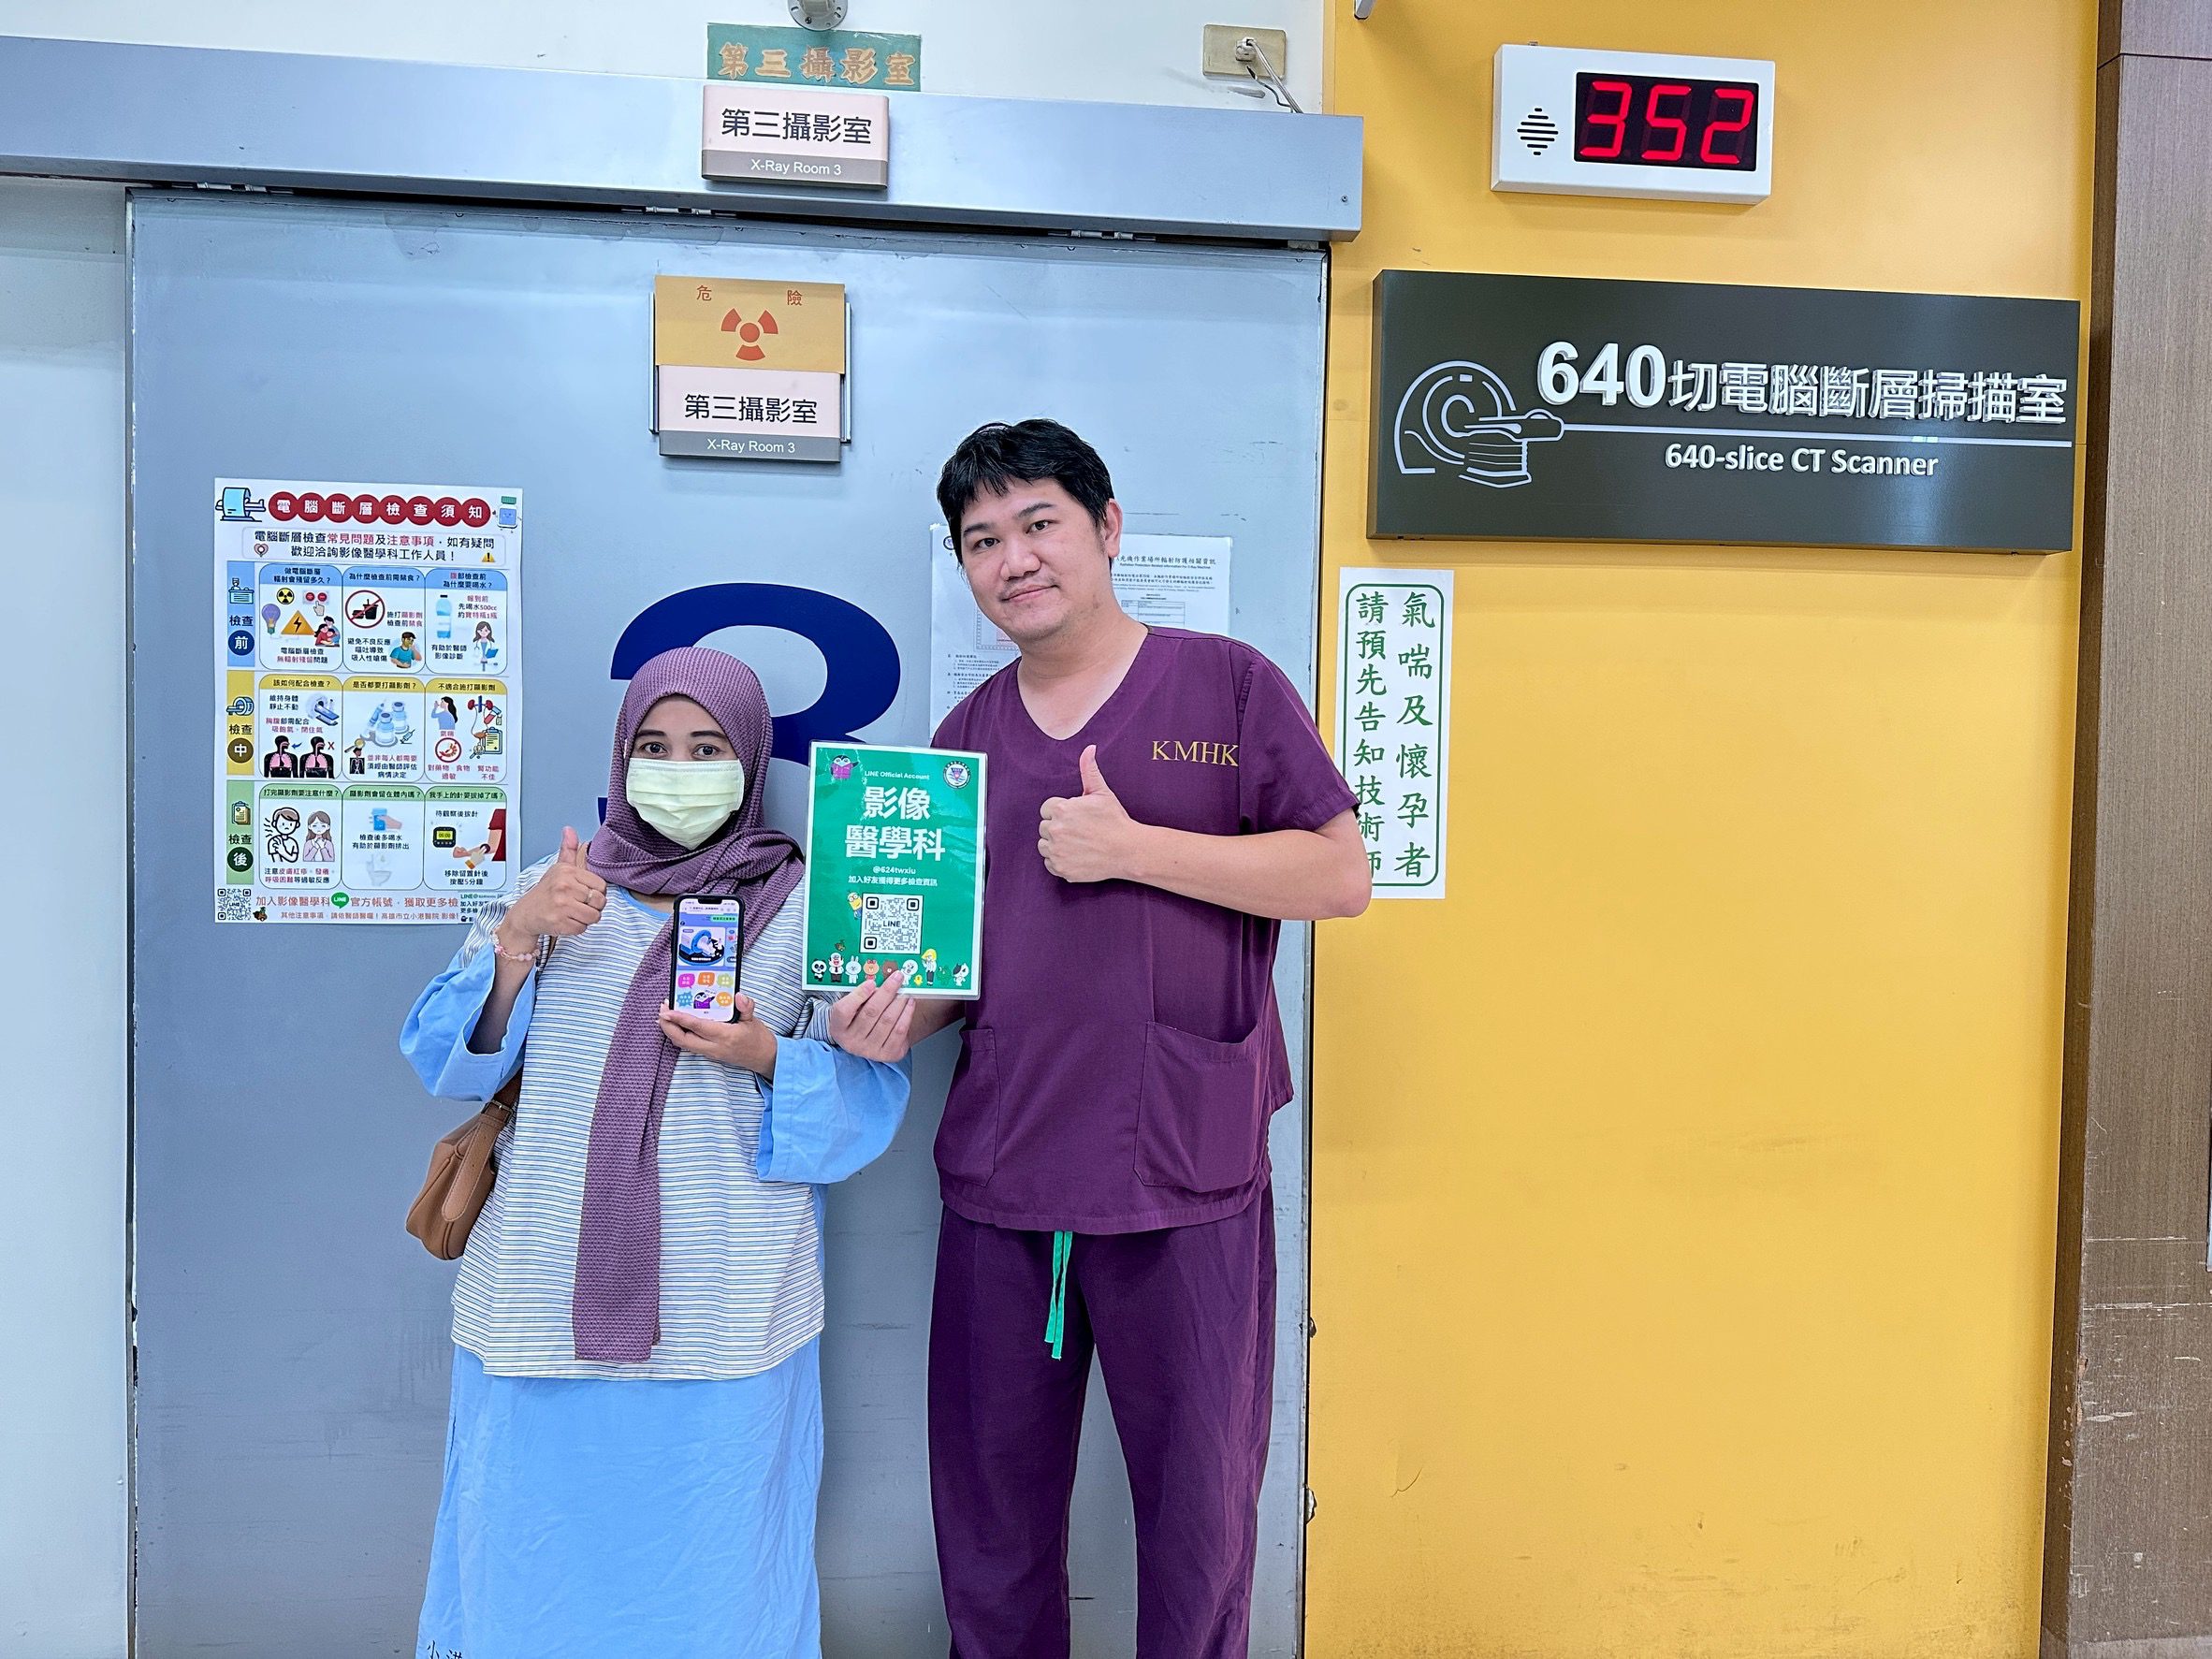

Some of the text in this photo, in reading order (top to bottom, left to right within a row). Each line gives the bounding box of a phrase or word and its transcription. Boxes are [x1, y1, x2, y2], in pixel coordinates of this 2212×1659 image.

[718, 42, 917, 86] 第三攝影室
[720, 108, 873, 146] 第三攝影室
[1580, 80, 1754, 165] 352
[750, 158, 842, 176] X-Ray Room 3
[1536, 341, 2068, 426] 640切電腦斷層掃描室
[684, 393, 819, 425] 第三攝影室
[706, 439, 795, 455] X-Ray Room 3
[1665, 442, 1939, 478] 640-slice CT Scanner
[277, 500, 482, 518] 電腦斷層檢查須知
[229, 615, 254, 627] 檢查
[235, 636, 248, 649] 前
[229, 724, 253, 735] 檢查
[1396, 591, 1435, 878] 氣喘及懷孕者
[234, 744, 247, 757] 中
[1151, 740, 1239, 766] KMHK
[863, 786, 930, 821] 影像
[228, 834, 253, 845] 檢查
[845, 824, 946, 861] 醫學科
[234, 852, 247, 866] 後
[256, 896, 329, 907] 加入影像醫學科
